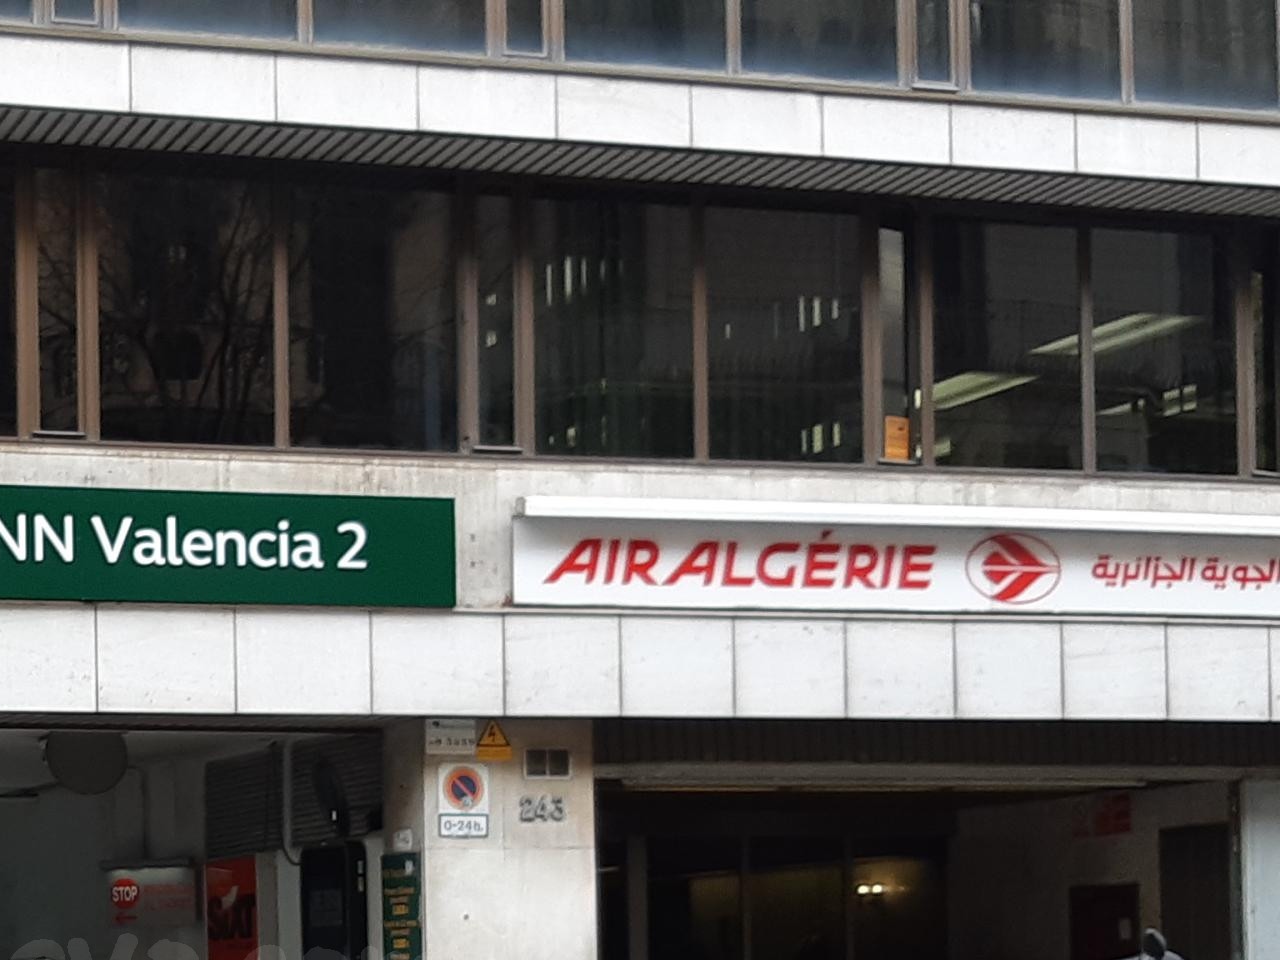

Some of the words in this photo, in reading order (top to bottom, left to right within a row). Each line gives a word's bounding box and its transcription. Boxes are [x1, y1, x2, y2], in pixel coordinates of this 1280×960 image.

[89, 515, 325, 569] Valencia
[335, 520, 369, 570] 2
[543, 536, 661, 585] AIR
[661, 529, 940, 590] ALGÉRIE
[519, 795, 565, 823] 243
[111, 885, 138, 902] STOP
